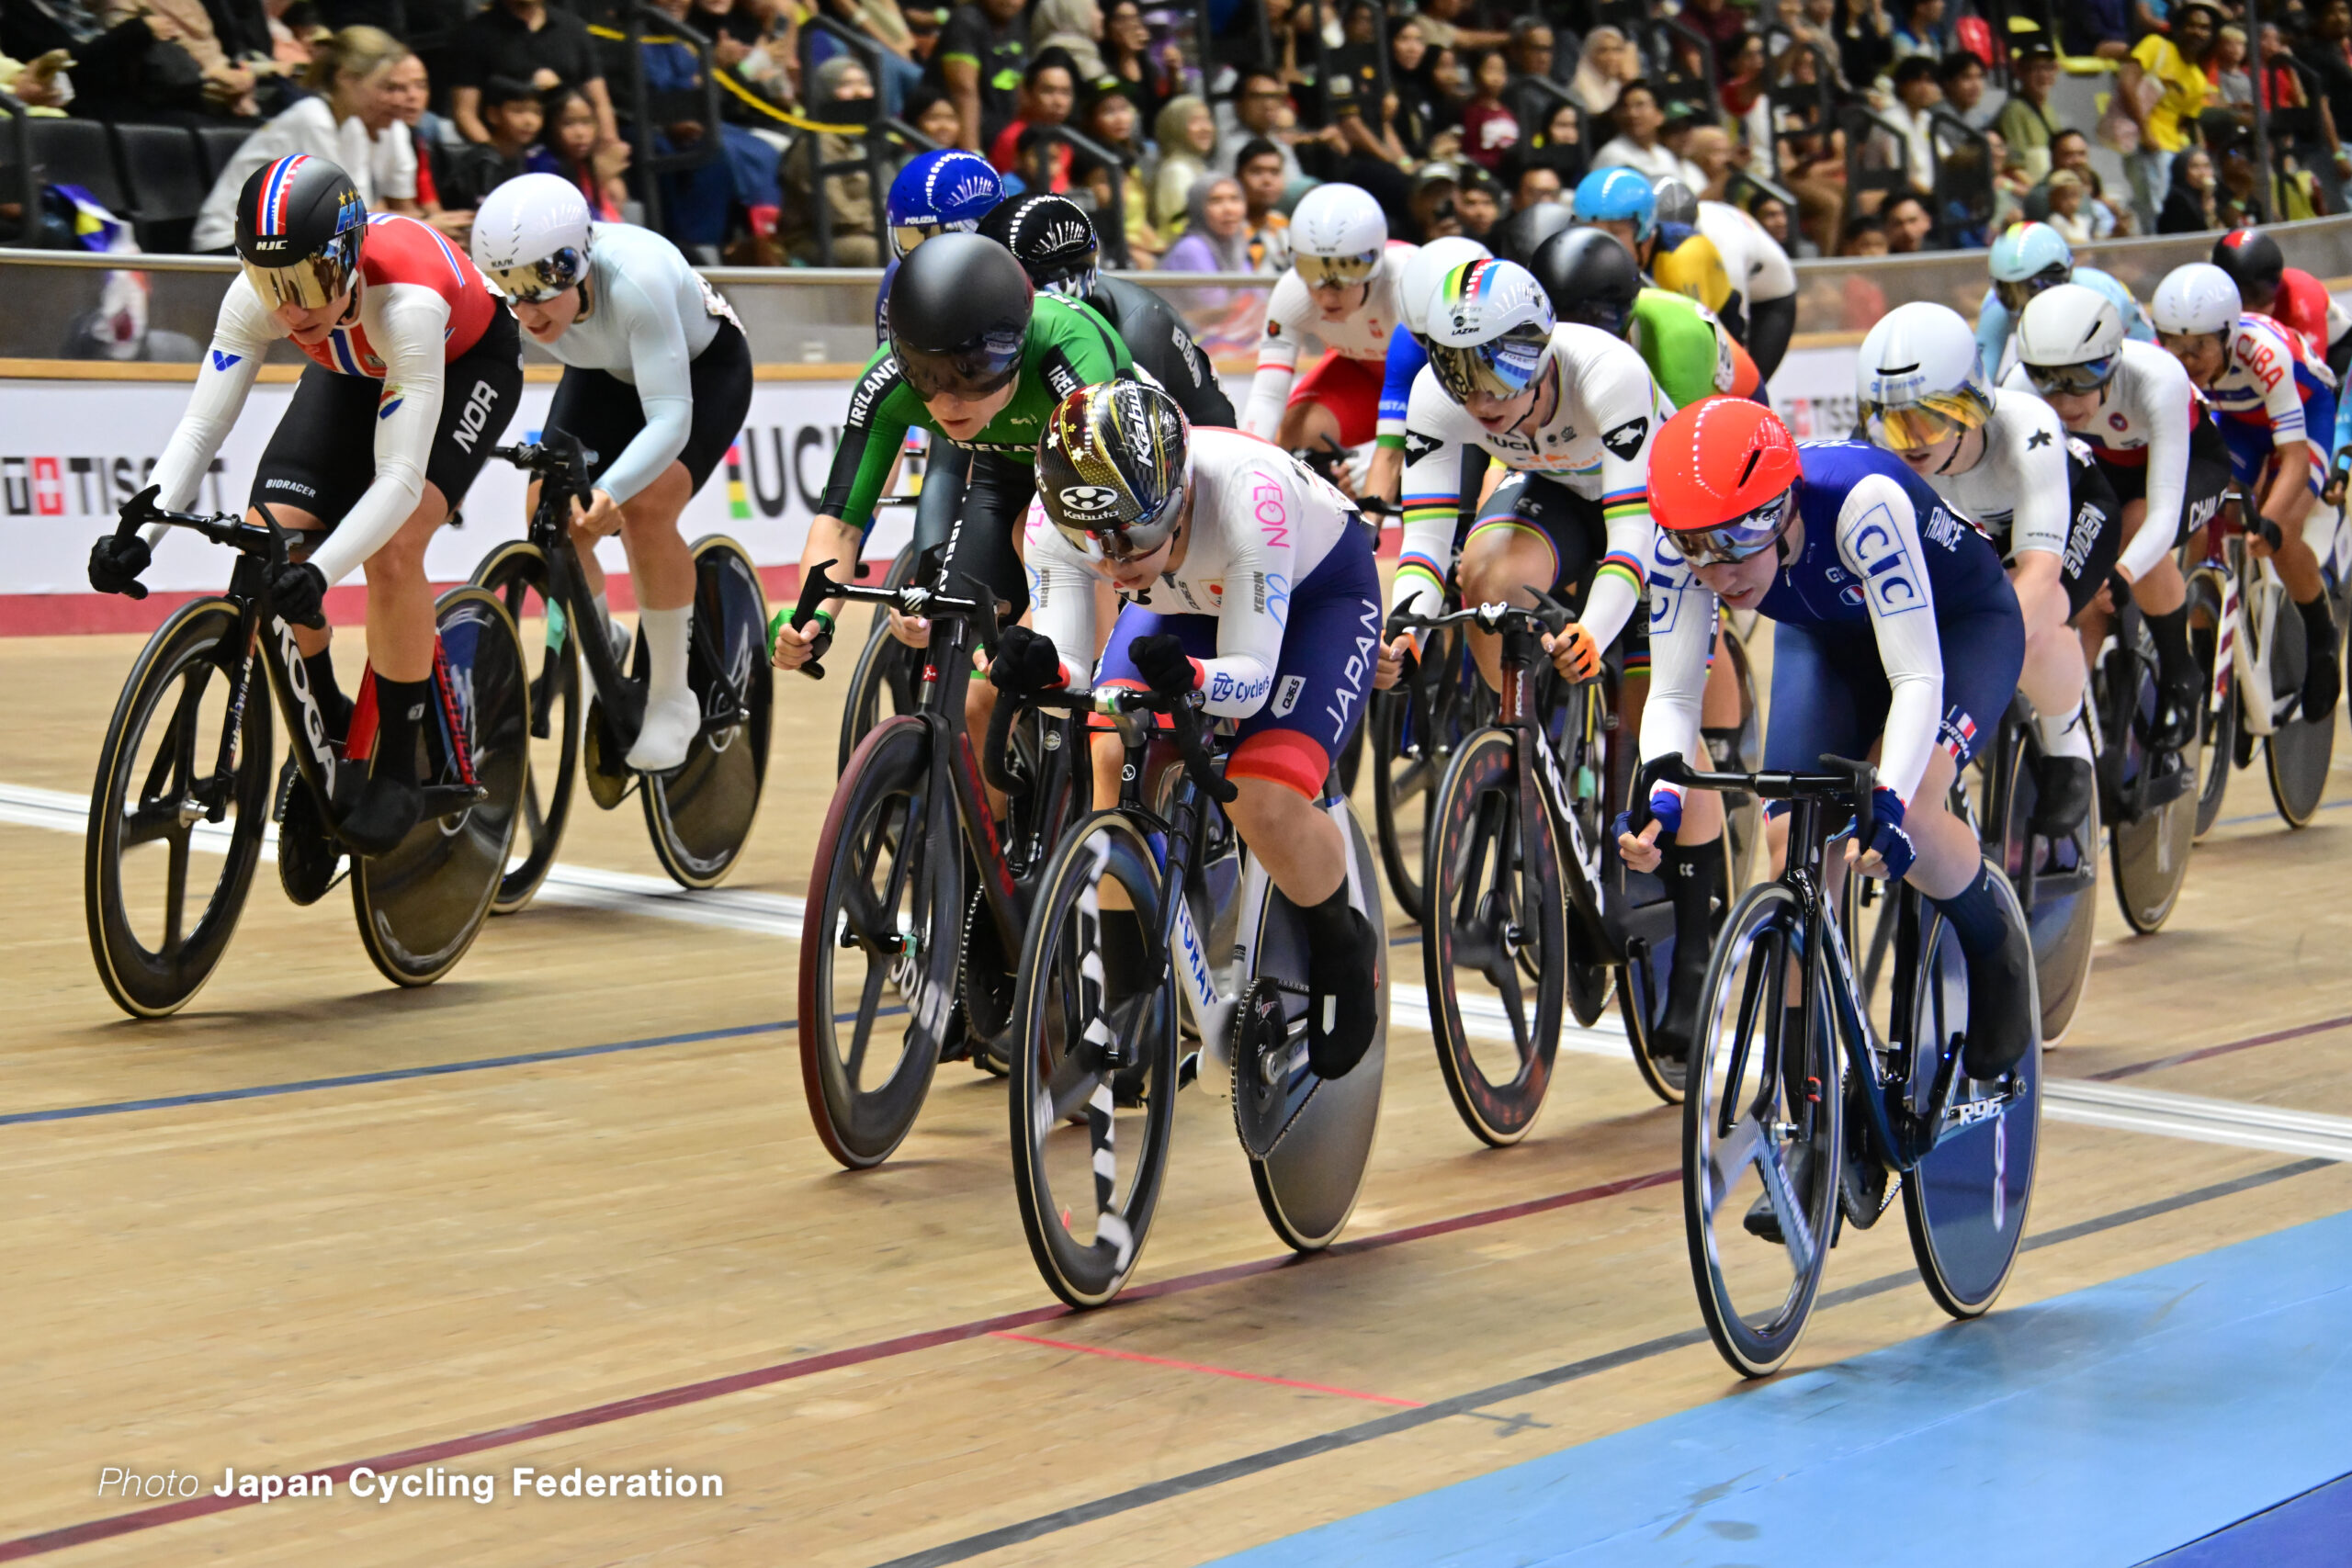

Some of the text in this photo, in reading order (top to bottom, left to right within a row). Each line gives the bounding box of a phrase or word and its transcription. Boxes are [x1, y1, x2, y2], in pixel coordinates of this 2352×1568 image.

[904, 214, 937, 226] POLIZIA
[255, 240, 288, 251] HJC
[1451, 326, 1480, 336] LAZER
[2236, 333, 2284, 393] CUBA
[452, 379, 499, 454] NOR
[1493, 435, 1530, 451] UCI
[69, 457, 224, 515] TIST
[266, 479, 316, 498] BIORACER
[1063, 509, 1120, 521] Kabuto
[1924, 505, 1966, 552] FRANCE
[1855, 525, 1914, 604] CIC
[1254, 571, 1264, 615] KEIRIN
[1327, 599, 1379, 744] JAPAN
[1515, 669, 1524, 717] KOGA
[272, 614, 336, 800] KOGA
